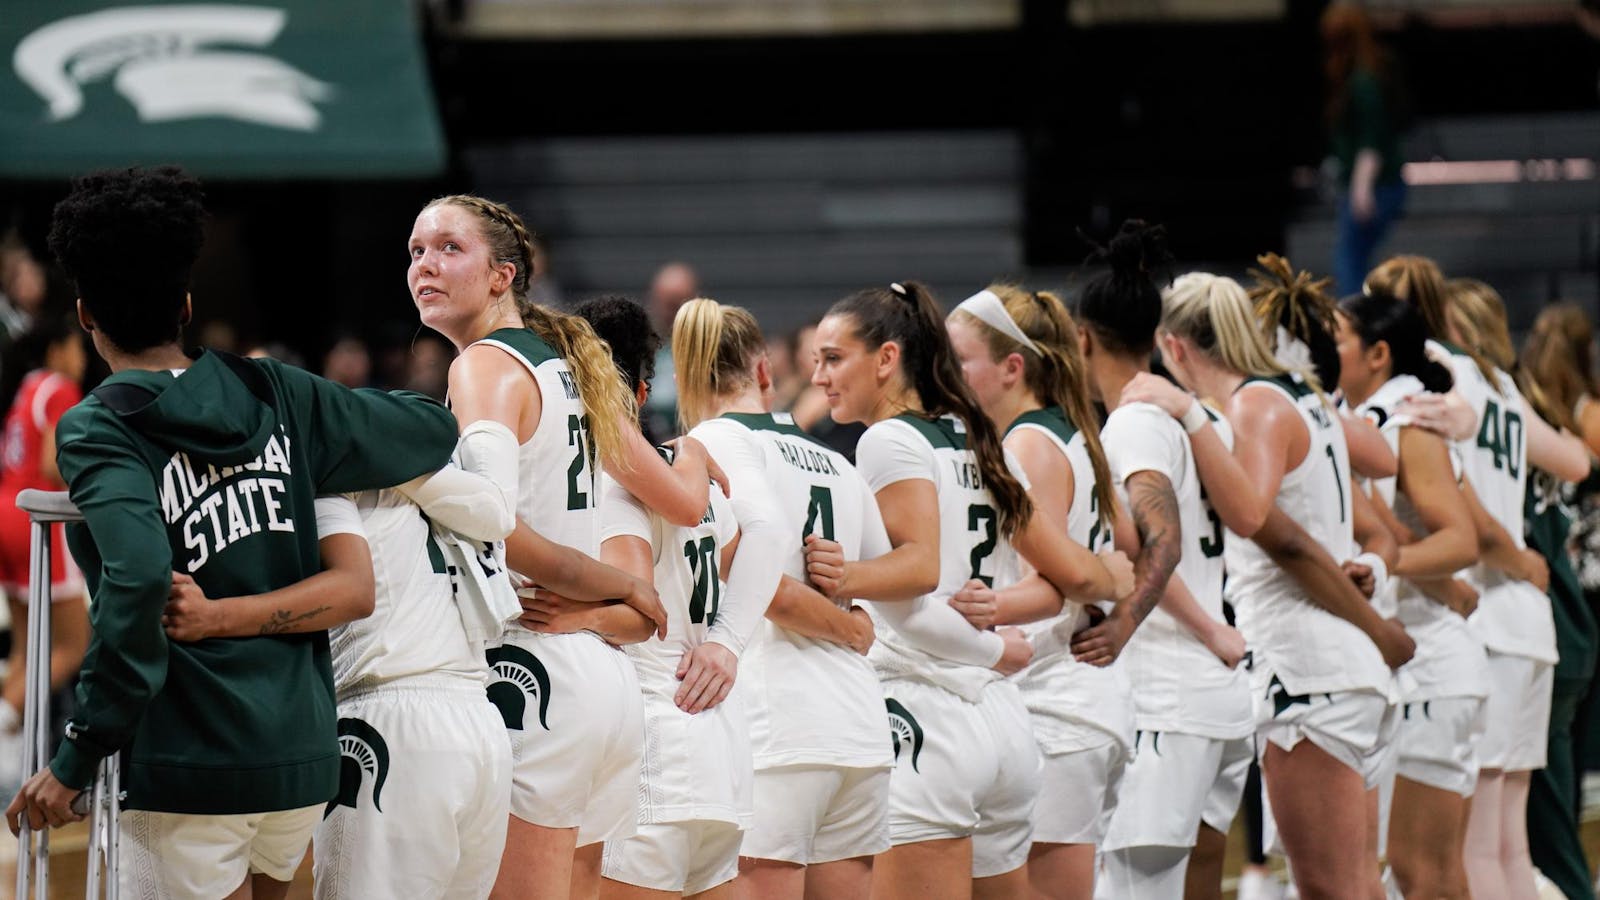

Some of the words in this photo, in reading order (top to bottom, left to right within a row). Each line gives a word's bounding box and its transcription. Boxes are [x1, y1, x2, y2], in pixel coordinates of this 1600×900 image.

[774, 439, 840, 476] HALLOCK
[1477, 400, 1522, 480] 40
[1326, 442, 1345, 523] 1
[183, 477, 295, 573] STATE
[968, 504, 997, 588] 2
[684, 535, 719, 627] 10
